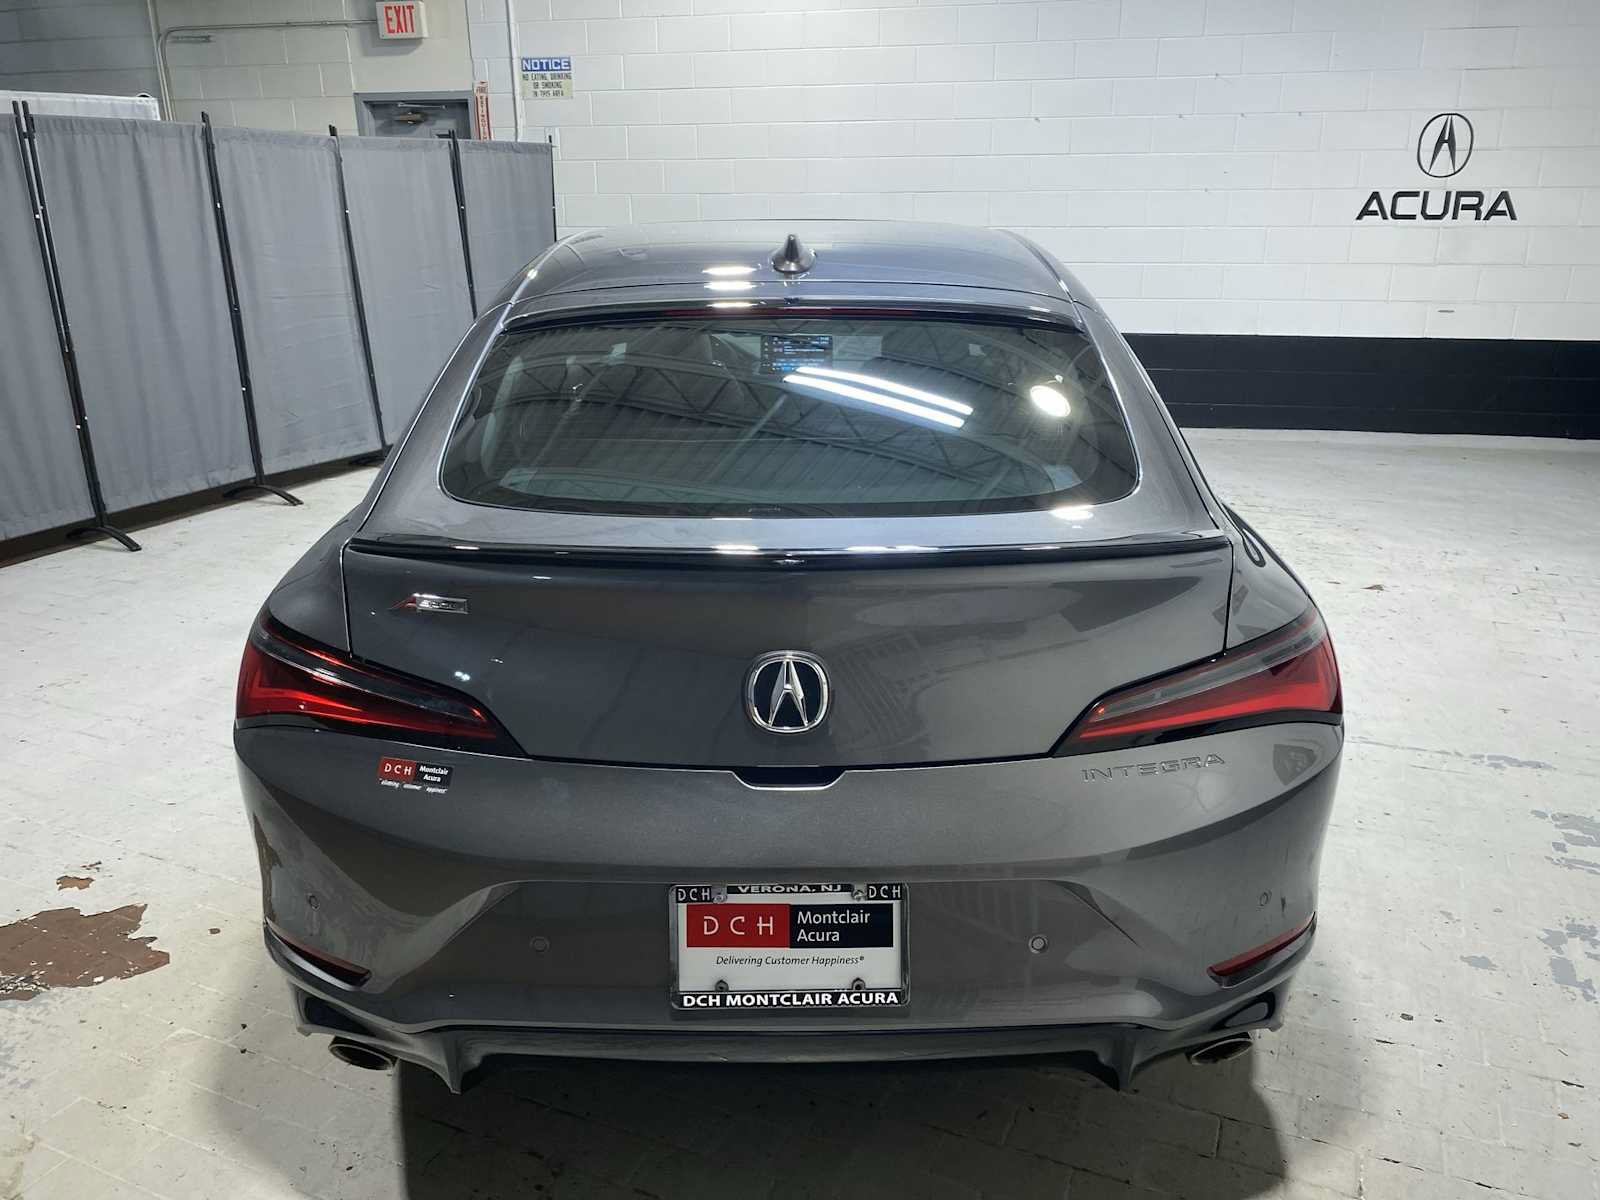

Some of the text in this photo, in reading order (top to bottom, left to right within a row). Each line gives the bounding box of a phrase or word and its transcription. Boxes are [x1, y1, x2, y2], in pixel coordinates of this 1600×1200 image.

[384, 4, 414, 34] EXIT
[522, 59, 570, 70] NOTICE
[1355, 190, 1518, 221] ACURA
[384, 762, 412, 776] DCH
[419, 765, 449, 776] Montclair
[1080, 753, 1226, 783] INTEGRA
[423, 774, 441, 782] Acura
[677, 887, 711, 902] DCH
[738, 884, 842, 893] VERONA, NJ
[868, 885, 901, 899] DCH
[797, 909, 871, 925] Montclair
[703, 915, 774, 936] DCH
[797, 928, 841, 942] Acura
[716, 955, 763, 968] Delivering
[765, 955, 809, 966] Customer
[682, 991, 899, 1007] DCH MONTCLAIR ACURA
